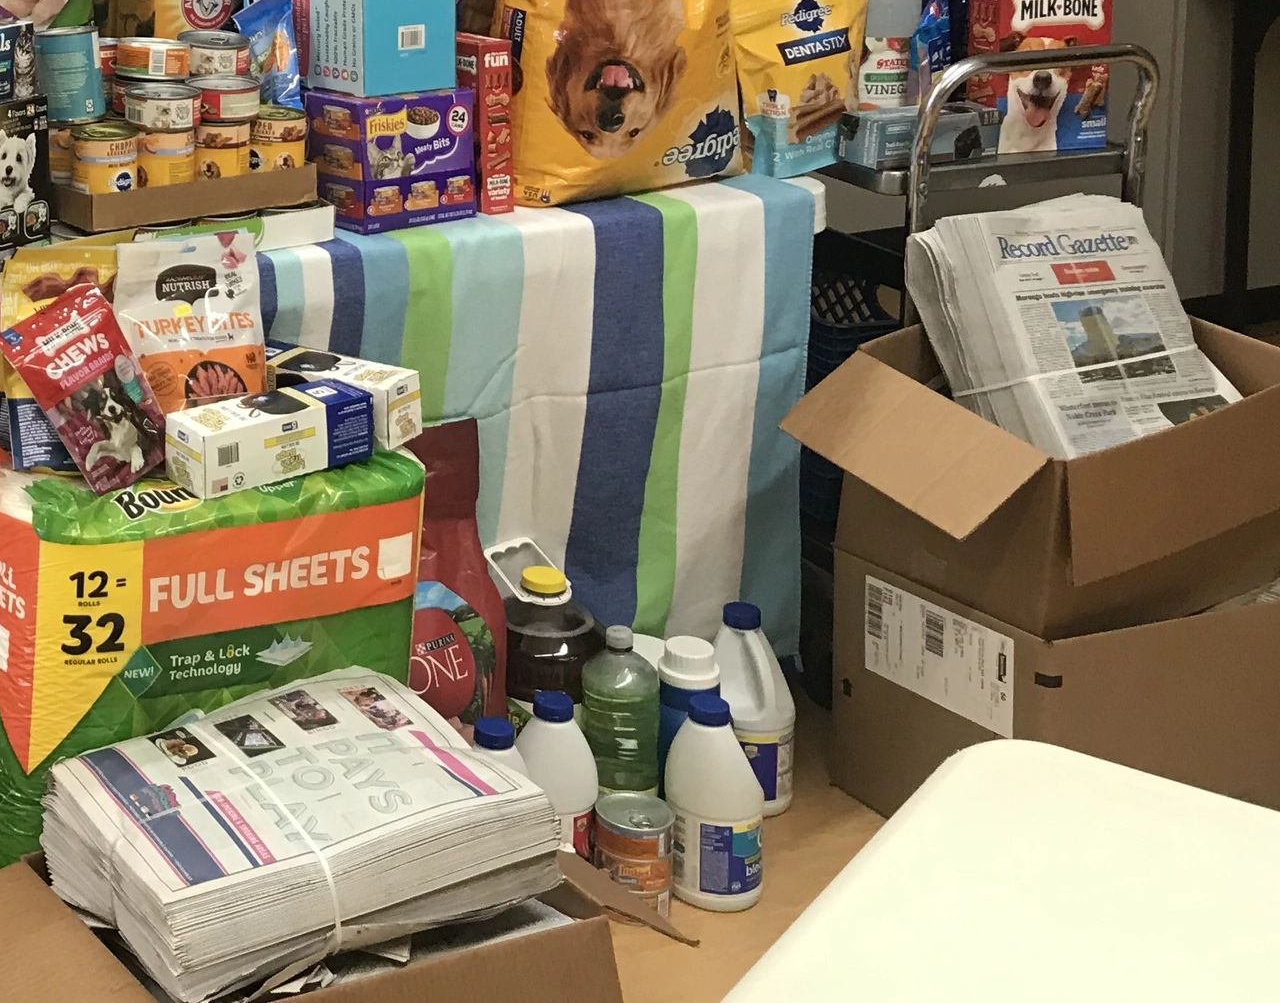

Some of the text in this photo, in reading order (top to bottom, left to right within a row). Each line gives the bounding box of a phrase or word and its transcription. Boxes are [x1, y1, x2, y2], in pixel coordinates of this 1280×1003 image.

[514, 11, 524, 42] ADULT
[780, 4, 832, 26] Pedigree
[784, 34, 847, 60] DENTASTIX
[484, 54, 509, 68] fun
[369, 117, 405, 134] Friskies
[452, 110, 466, 123] 24
[1081, 117, 1107, 128] small
[414, 137, 451, 154] Meaty Bits
[997, 233, 1129, 259] Record Gazette
[162, 280, 210, 293] NUTRISH
[133, 315, 205, 339] TURKEY
[46, 332, 110, 380] CHEWS
[59, 366, 91, 390] FLAVOR
[69, 570, 109, 599] 12
[149, 545, 371, 613] FULL SHEETS
[60, 612, 126, 656] 32
[426, 634, 455, 651] PURINA
[64, 657, 118, 666] REGULAR ROLLS
[169, 653, 202, 668] Trap
[204, 650, 215, 662] &
[410, 644, 469, 695] ONE
[124, 666, 155, 679] NEW!
[169, 661, 242, 681] Technology
[275, 747, 335, 791] TO
[312, 738, 413, 814] PAYS
